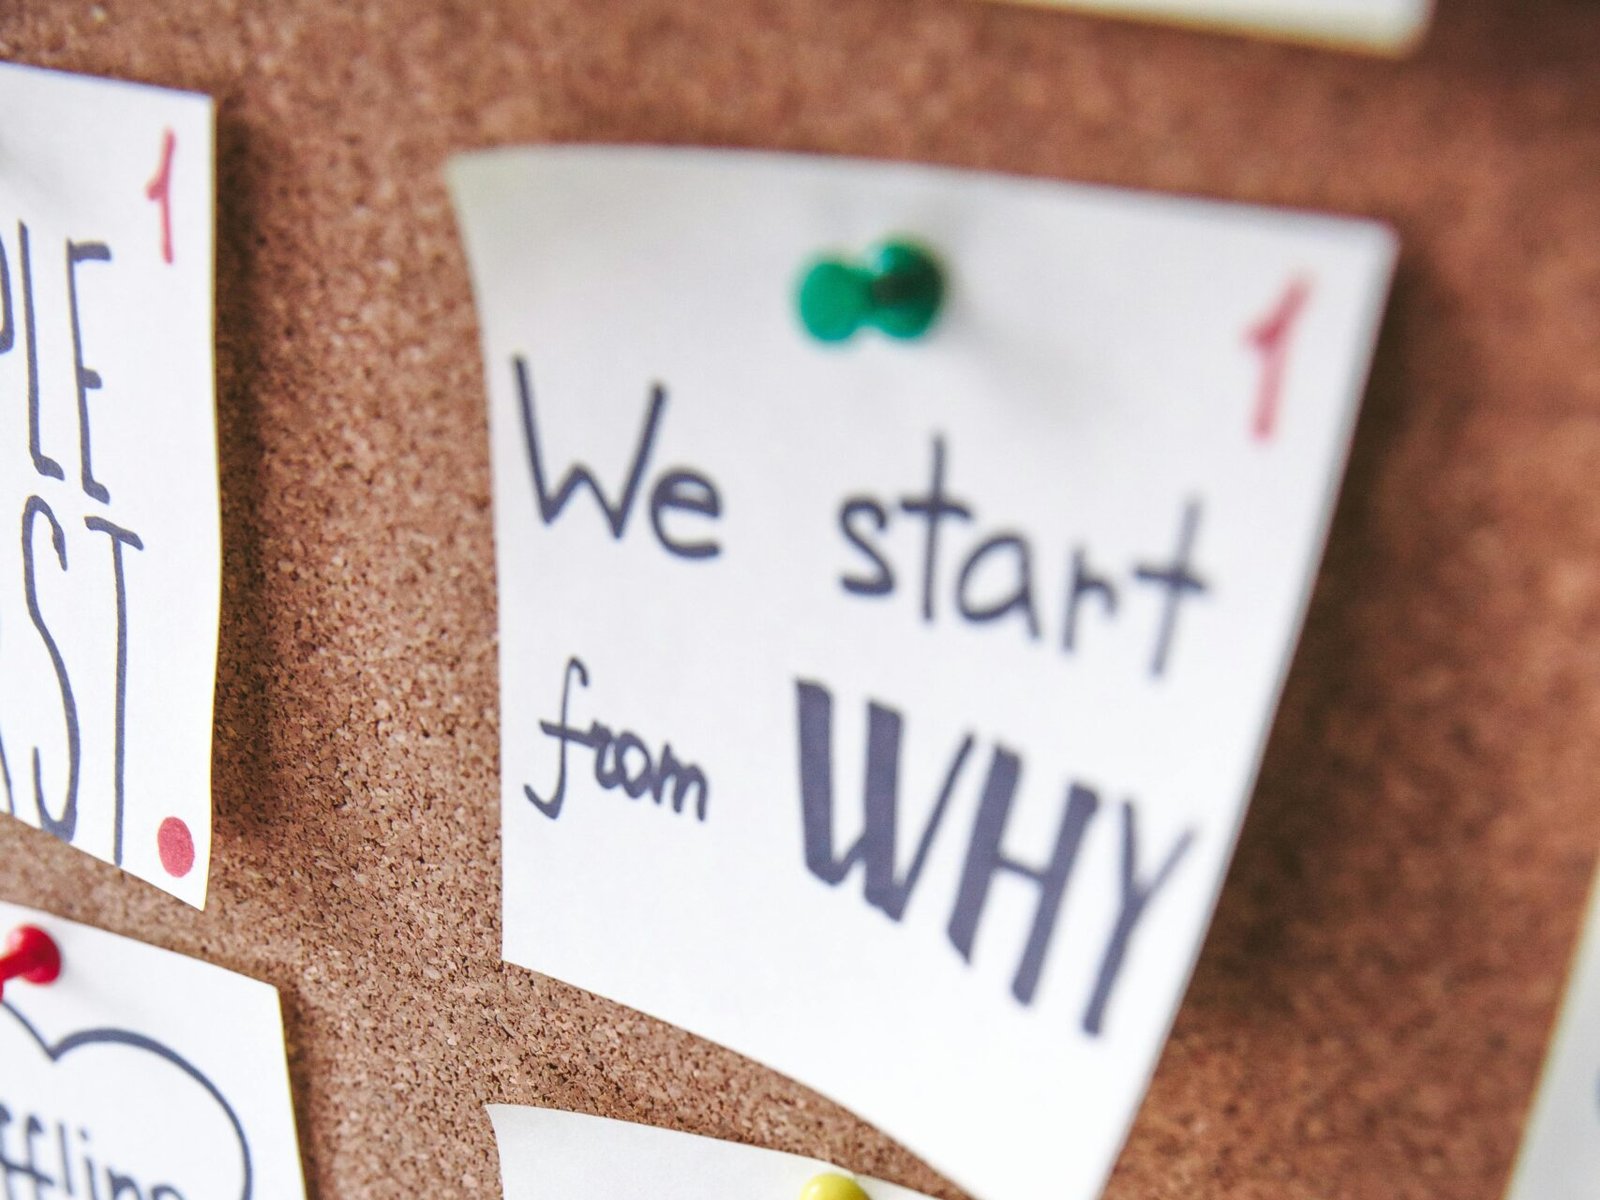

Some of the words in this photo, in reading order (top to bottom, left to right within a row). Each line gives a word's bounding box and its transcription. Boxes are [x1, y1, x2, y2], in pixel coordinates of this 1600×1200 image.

[147, 127, 175, 264] 1
[1241, 266, 1316, 446] 1
[508, 353, 725, 562] We
[836, 428, 1211, 684] start
[523, 655, 710, 823] from
[792, 674, 1197, 1041] WHY
